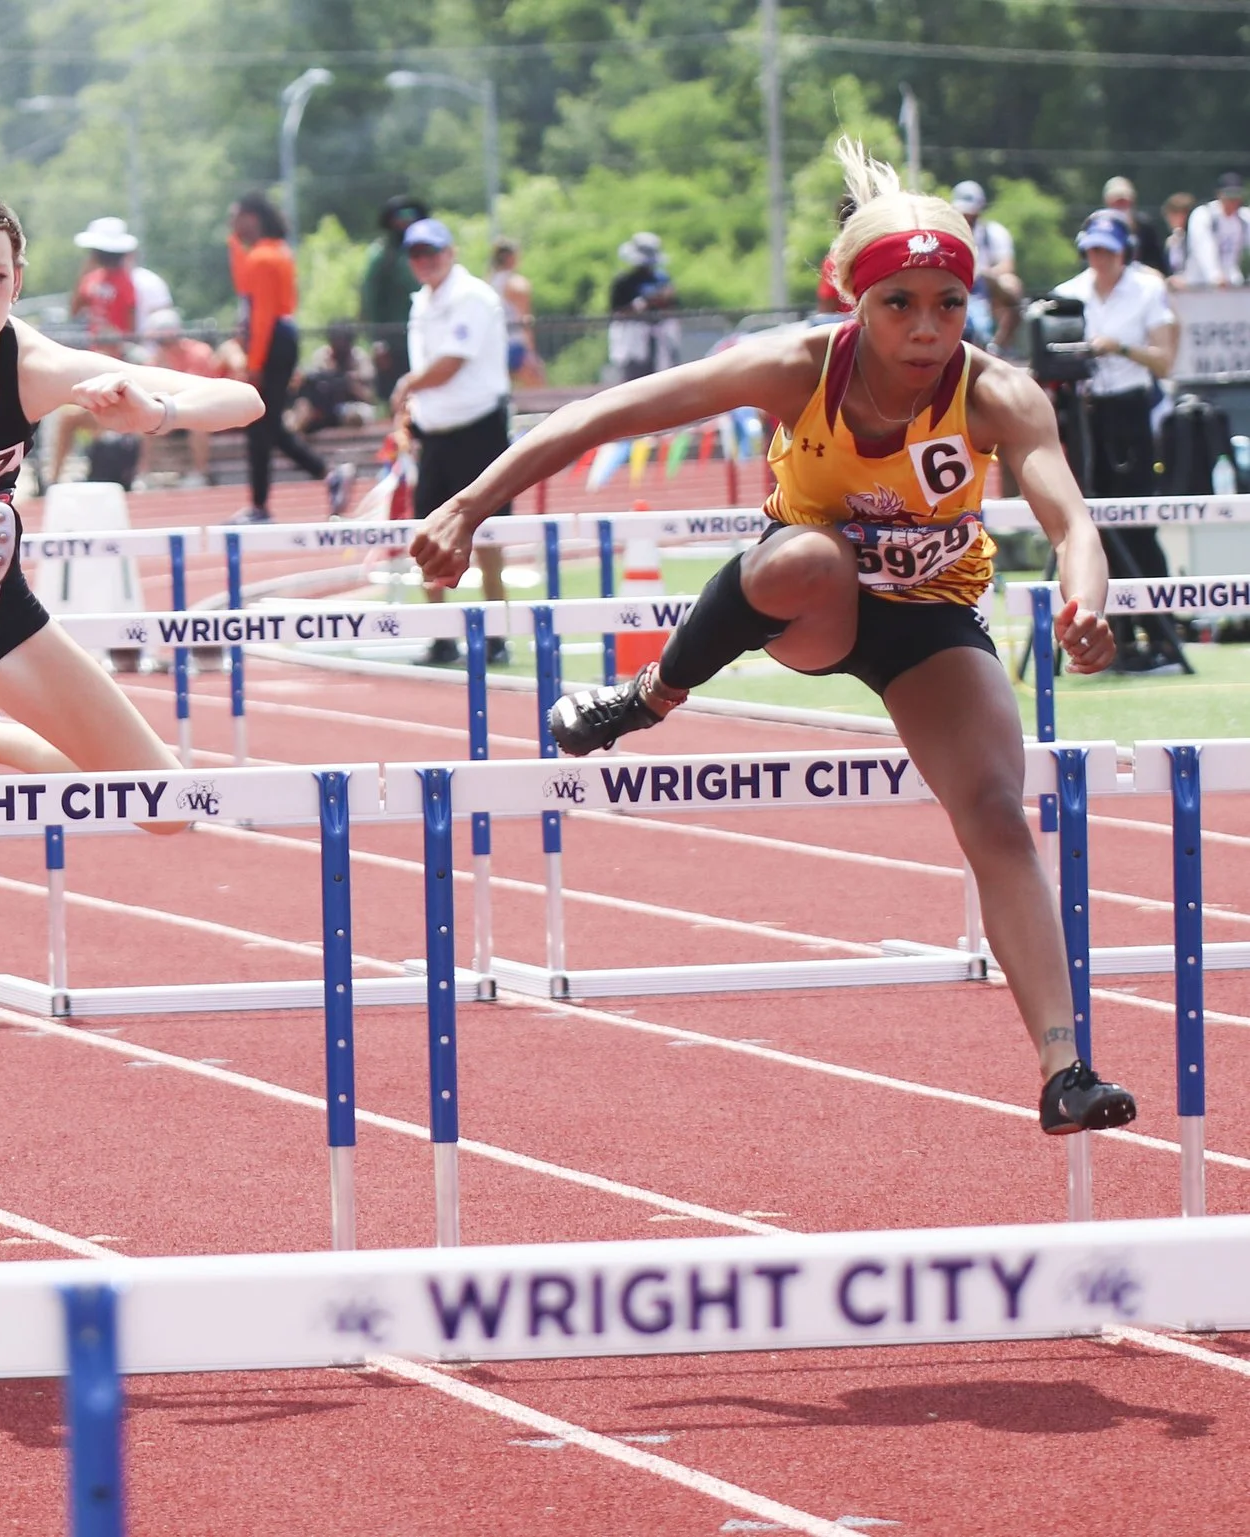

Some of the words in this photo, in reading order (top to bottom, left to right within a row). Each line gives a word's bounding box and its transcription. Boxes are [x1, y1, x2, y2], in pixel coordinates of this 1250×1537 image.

[921, 443, 967, 494] 6
[686, 515, 766, 535] WRIGH
[1087, 503, 1150, 522] IGHT
[1157, 502, 1208, 521] CITY
[41, 539, 94, 558] CITY
[315, 527, 411, 547] WRIGHT
[858, 524, 969, 579] 5929
[1147, 582, 1250, 609] WRIGH
[158, 615, 286, 643] WRIGHT
[295, 612, 366, 639] CITY
[600, 761, 791, 803] WRIGHT
[804, 758, 910, 798] CITY
[60, 780, 169, 820] CITY
[427, 1263, 803, 1342] WRIGHT
[836, 1251, 1038, 1328] CITY
